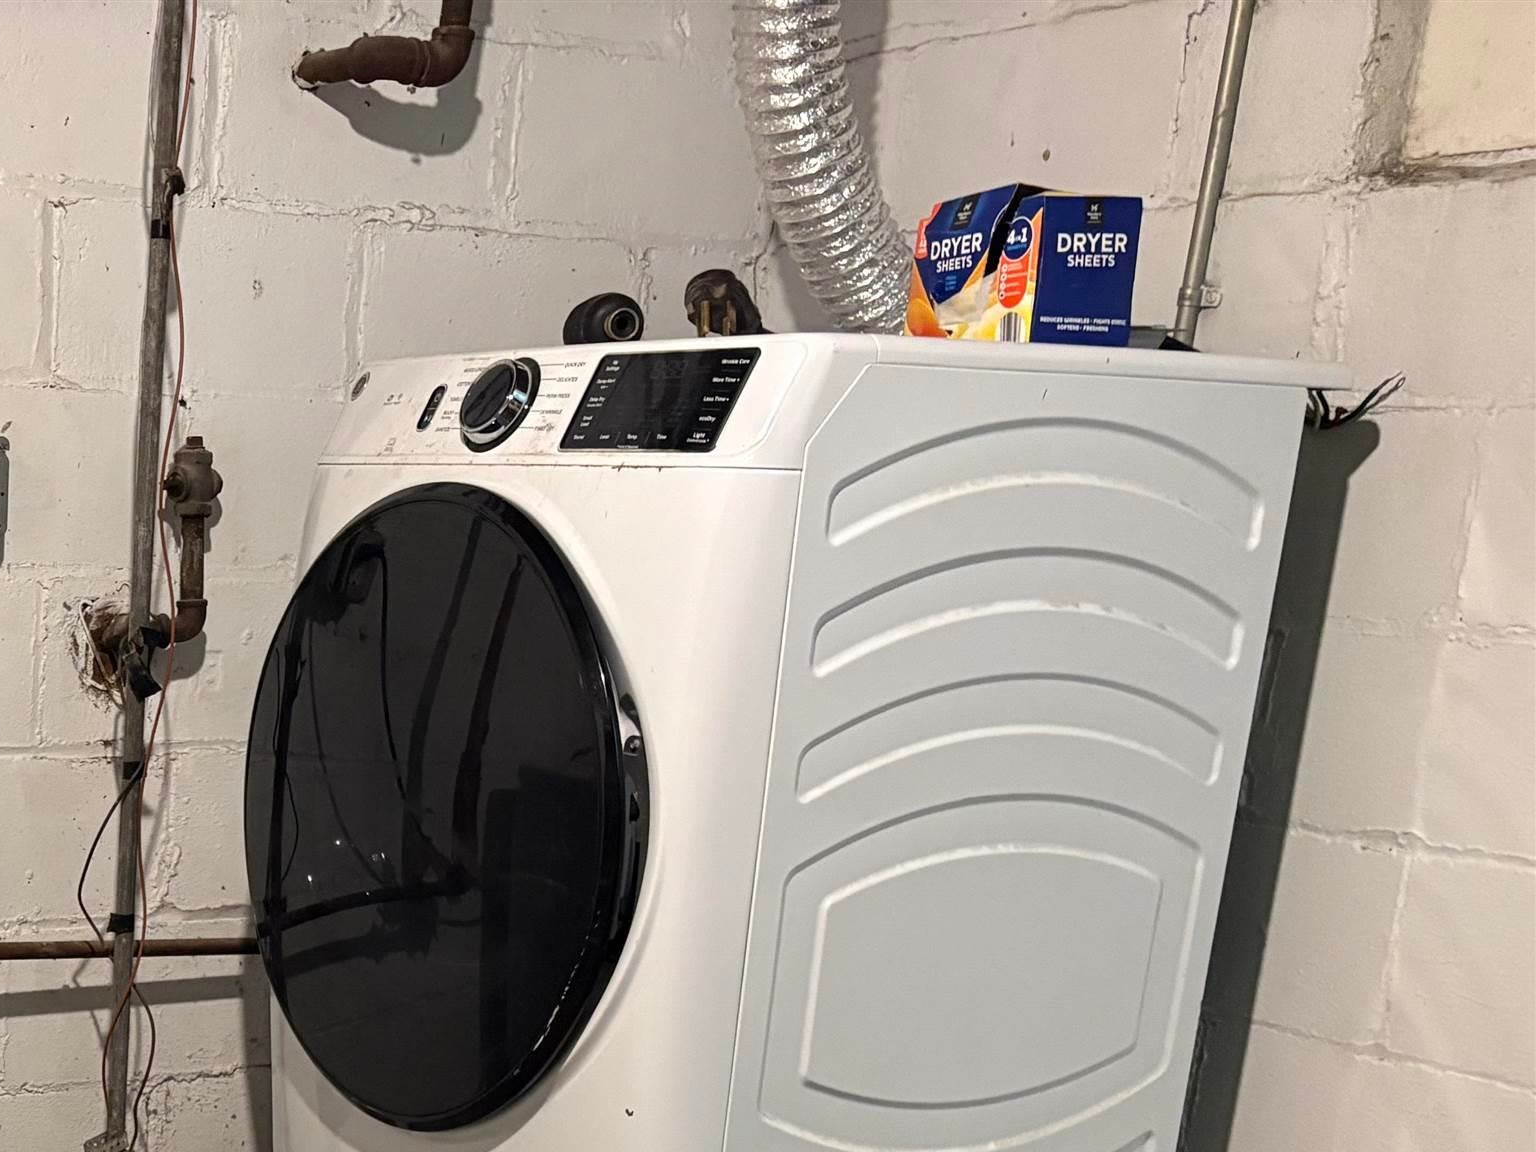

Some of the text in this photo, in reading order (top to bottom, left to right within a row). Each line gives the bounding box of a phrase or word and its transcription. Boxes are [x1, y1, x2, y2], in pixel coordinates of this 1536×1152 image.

[930, 232, 983, 261] DRYER
[1057, 232, 1128, 254] DRYER
[936, 255, 973, 273] SHEETS
[1066, 254, 1116, 268] SHEETS
